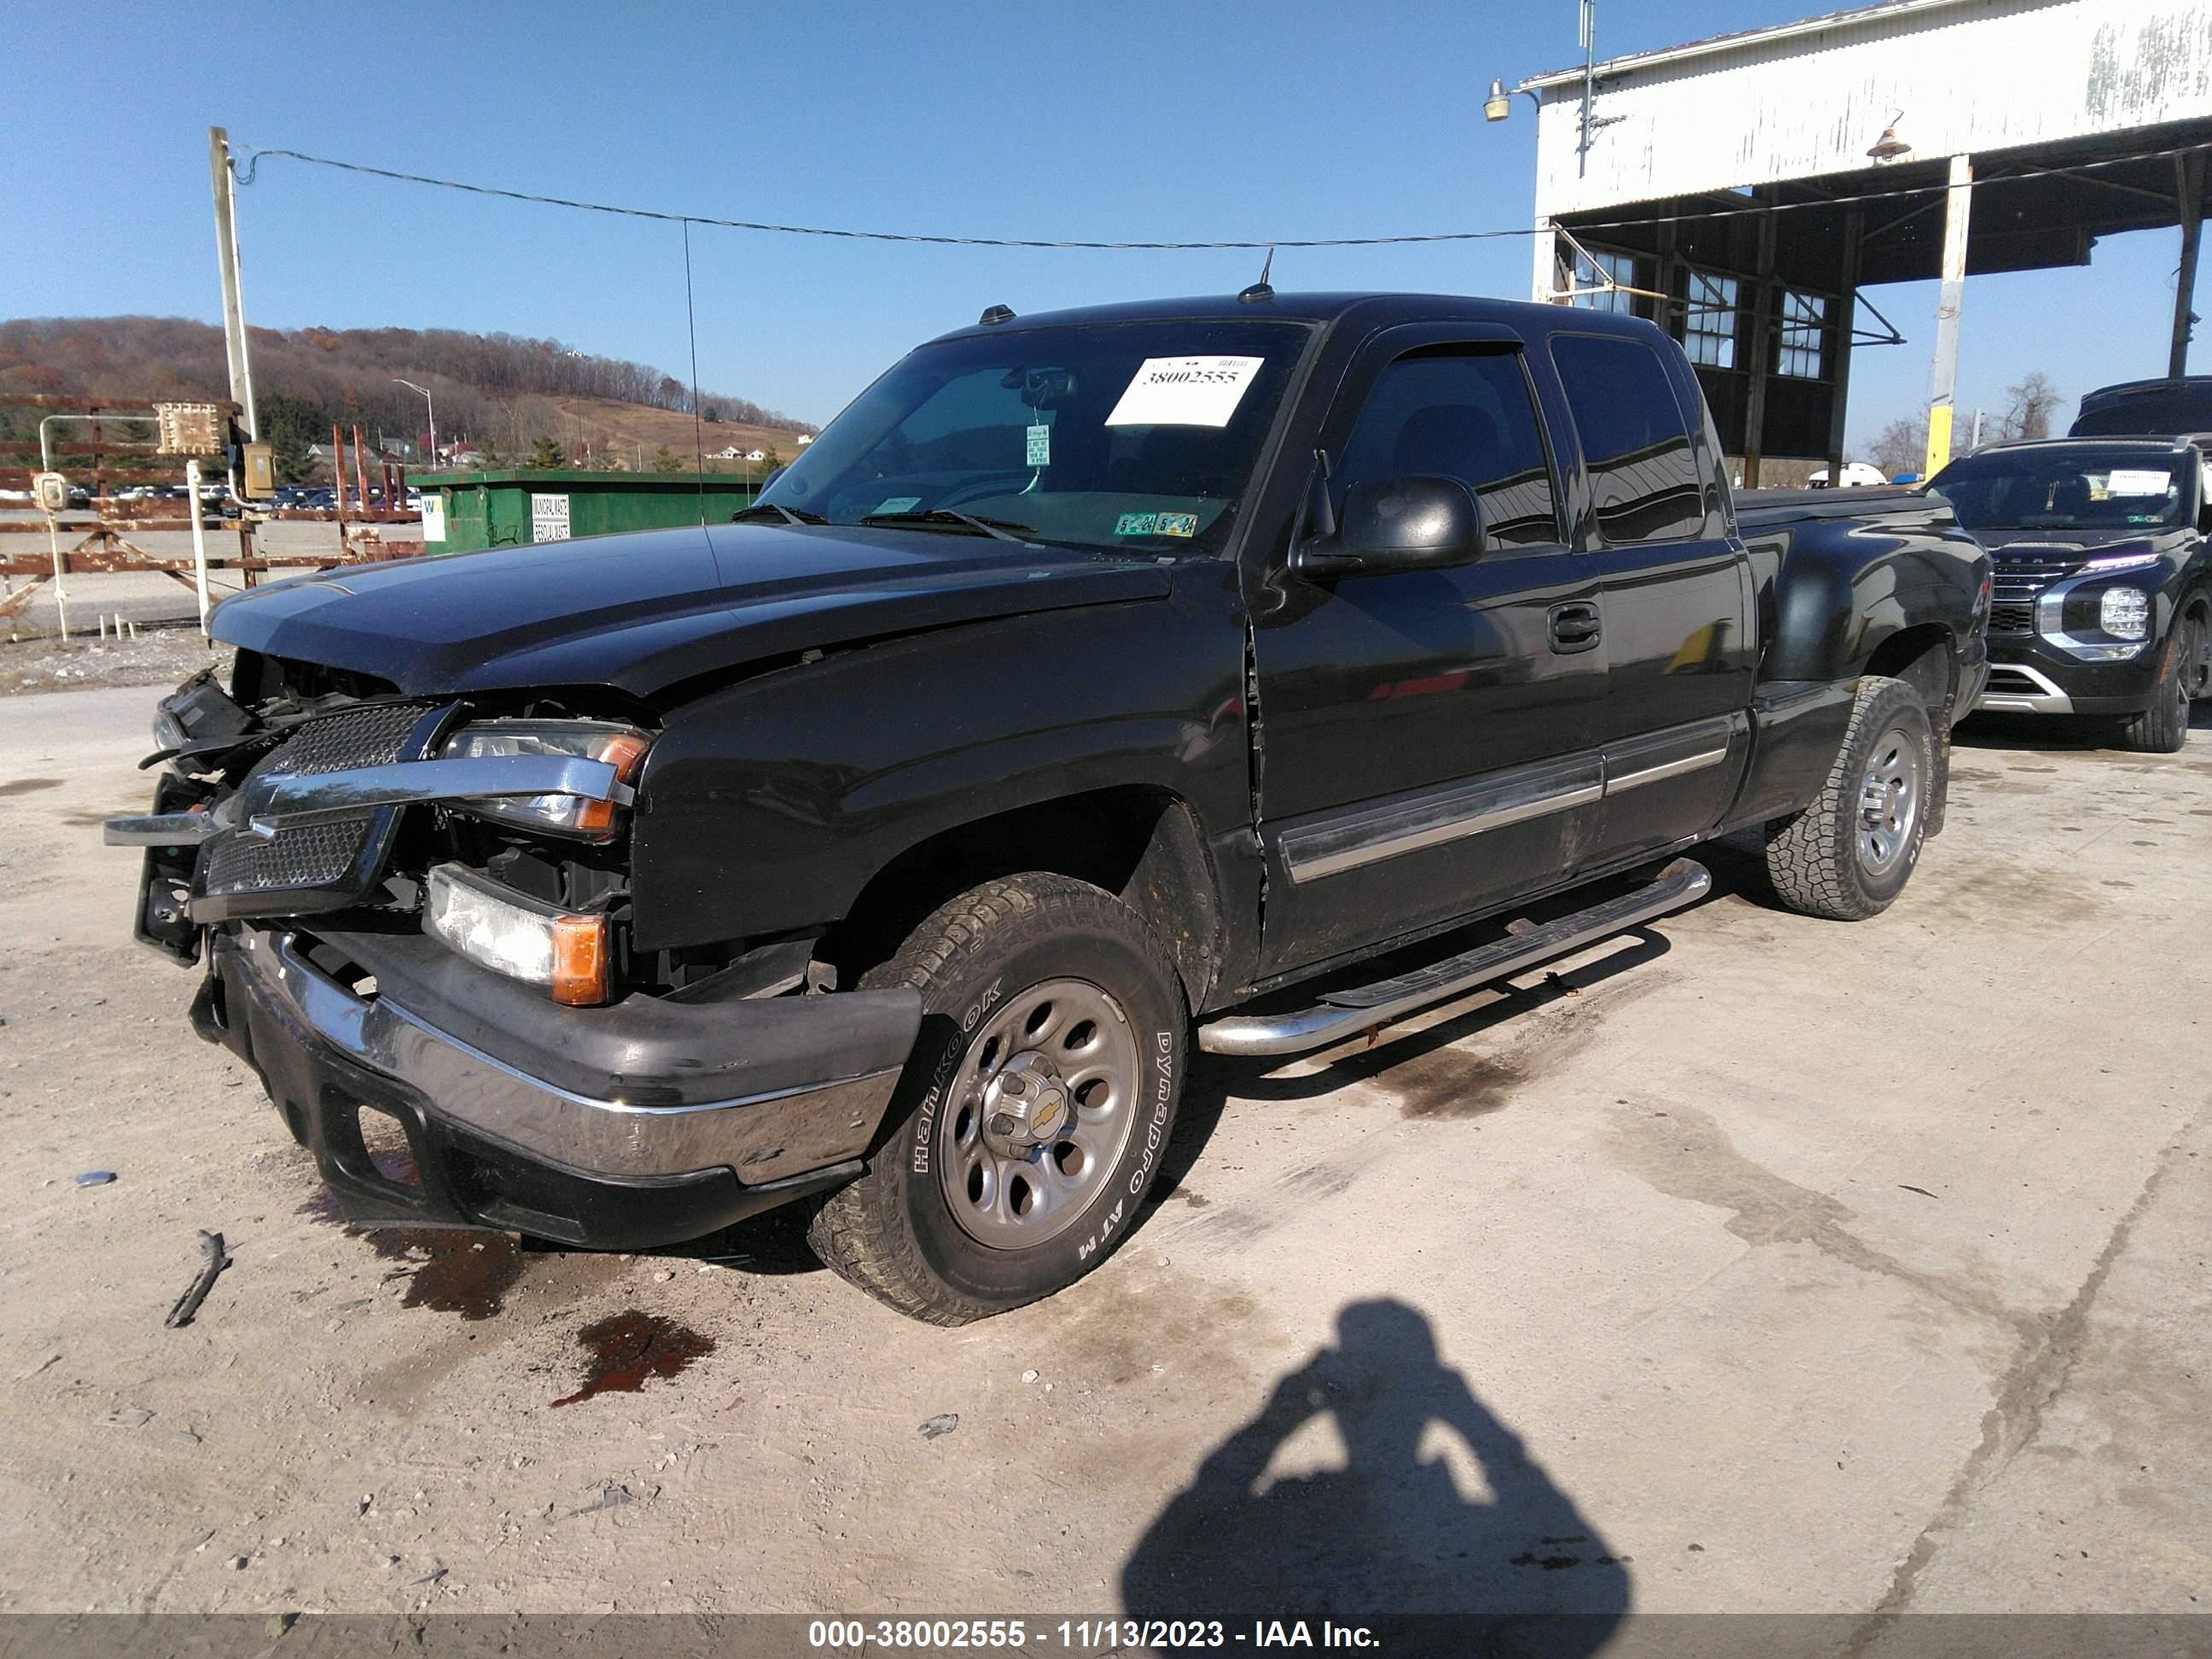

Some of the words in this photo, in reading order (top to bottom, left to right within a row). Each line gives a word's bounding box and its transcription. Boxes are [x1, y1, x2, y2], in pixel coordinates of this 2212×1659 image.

[1143, 370, 1239, 384] 38002555
[555, 498, 568, 516] WASTE
[1142, 516, 1154, 532] 24
[1182, 517, 1195, 533] 24
[535, 524, 554, 541] RESIDUAL
[555, 524, 568, 540] WASTE
